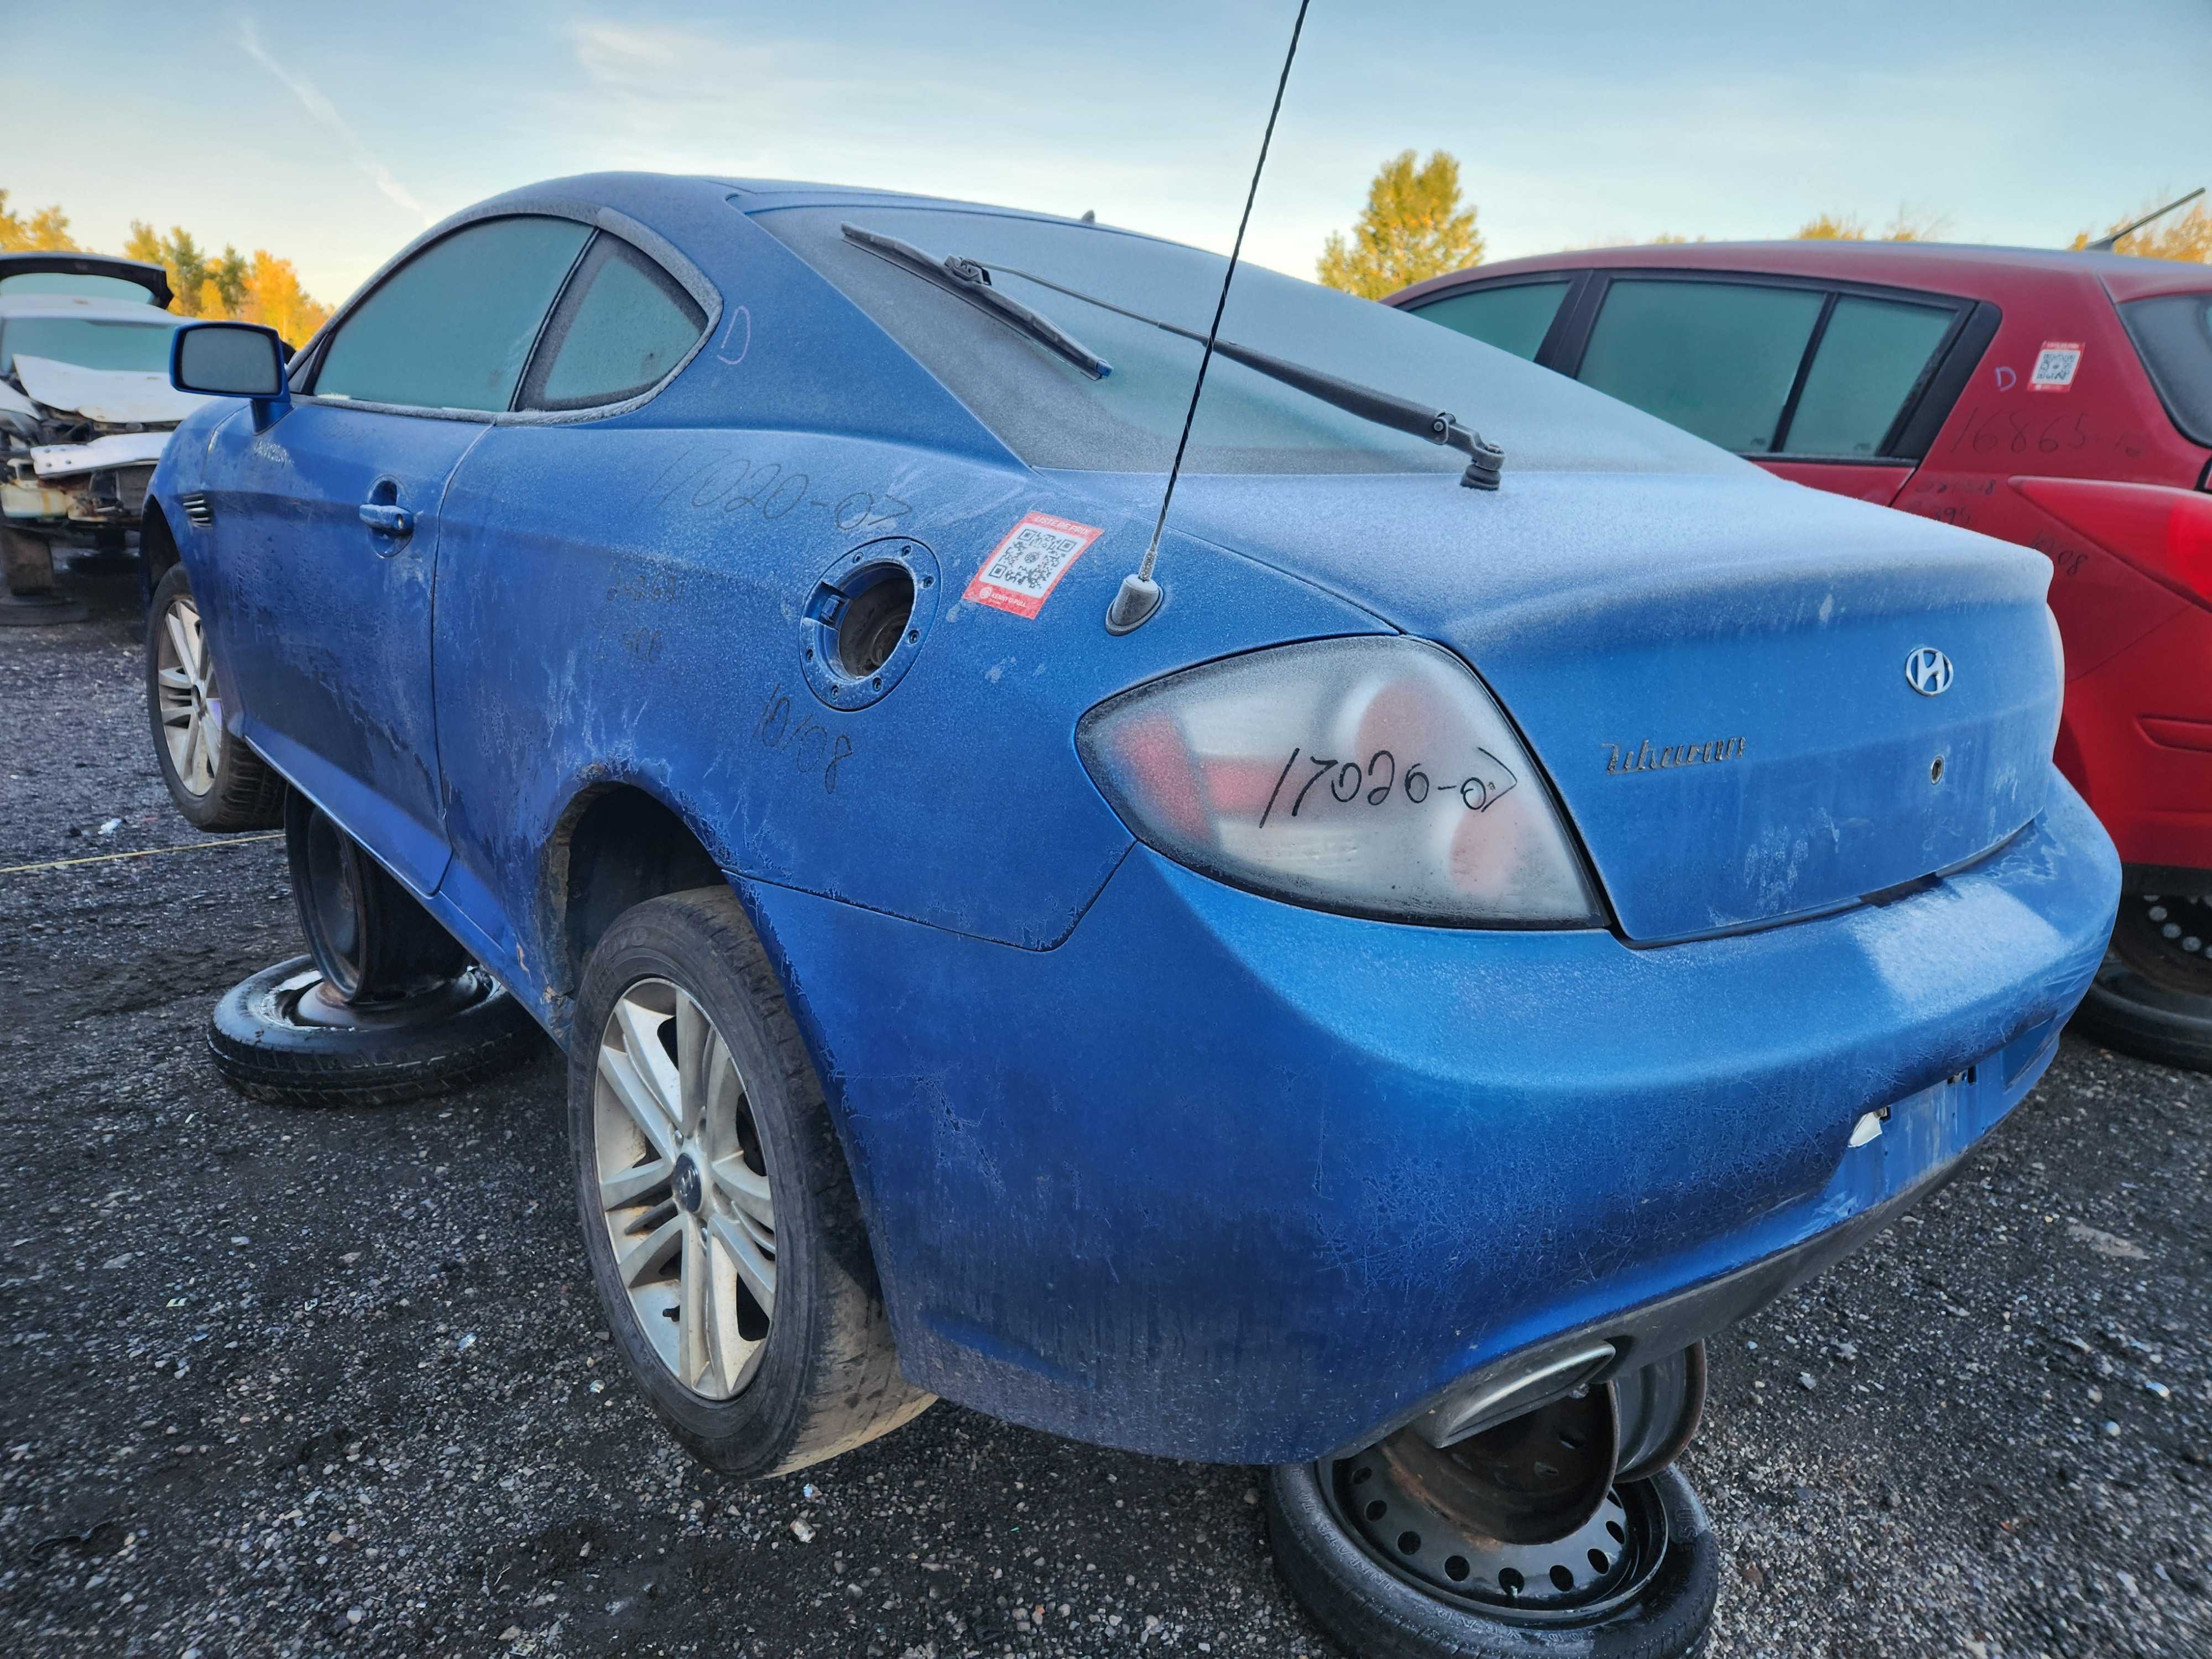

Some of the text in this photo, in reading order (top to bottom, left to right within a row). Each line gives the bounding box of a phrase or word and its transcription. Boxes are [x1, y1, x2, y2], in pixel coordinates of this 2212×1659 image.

[1995, 366, 2017, 392] D
[1055, 521, 1071, 530] DE
[1069, 524, 1092, 535] PRIX
